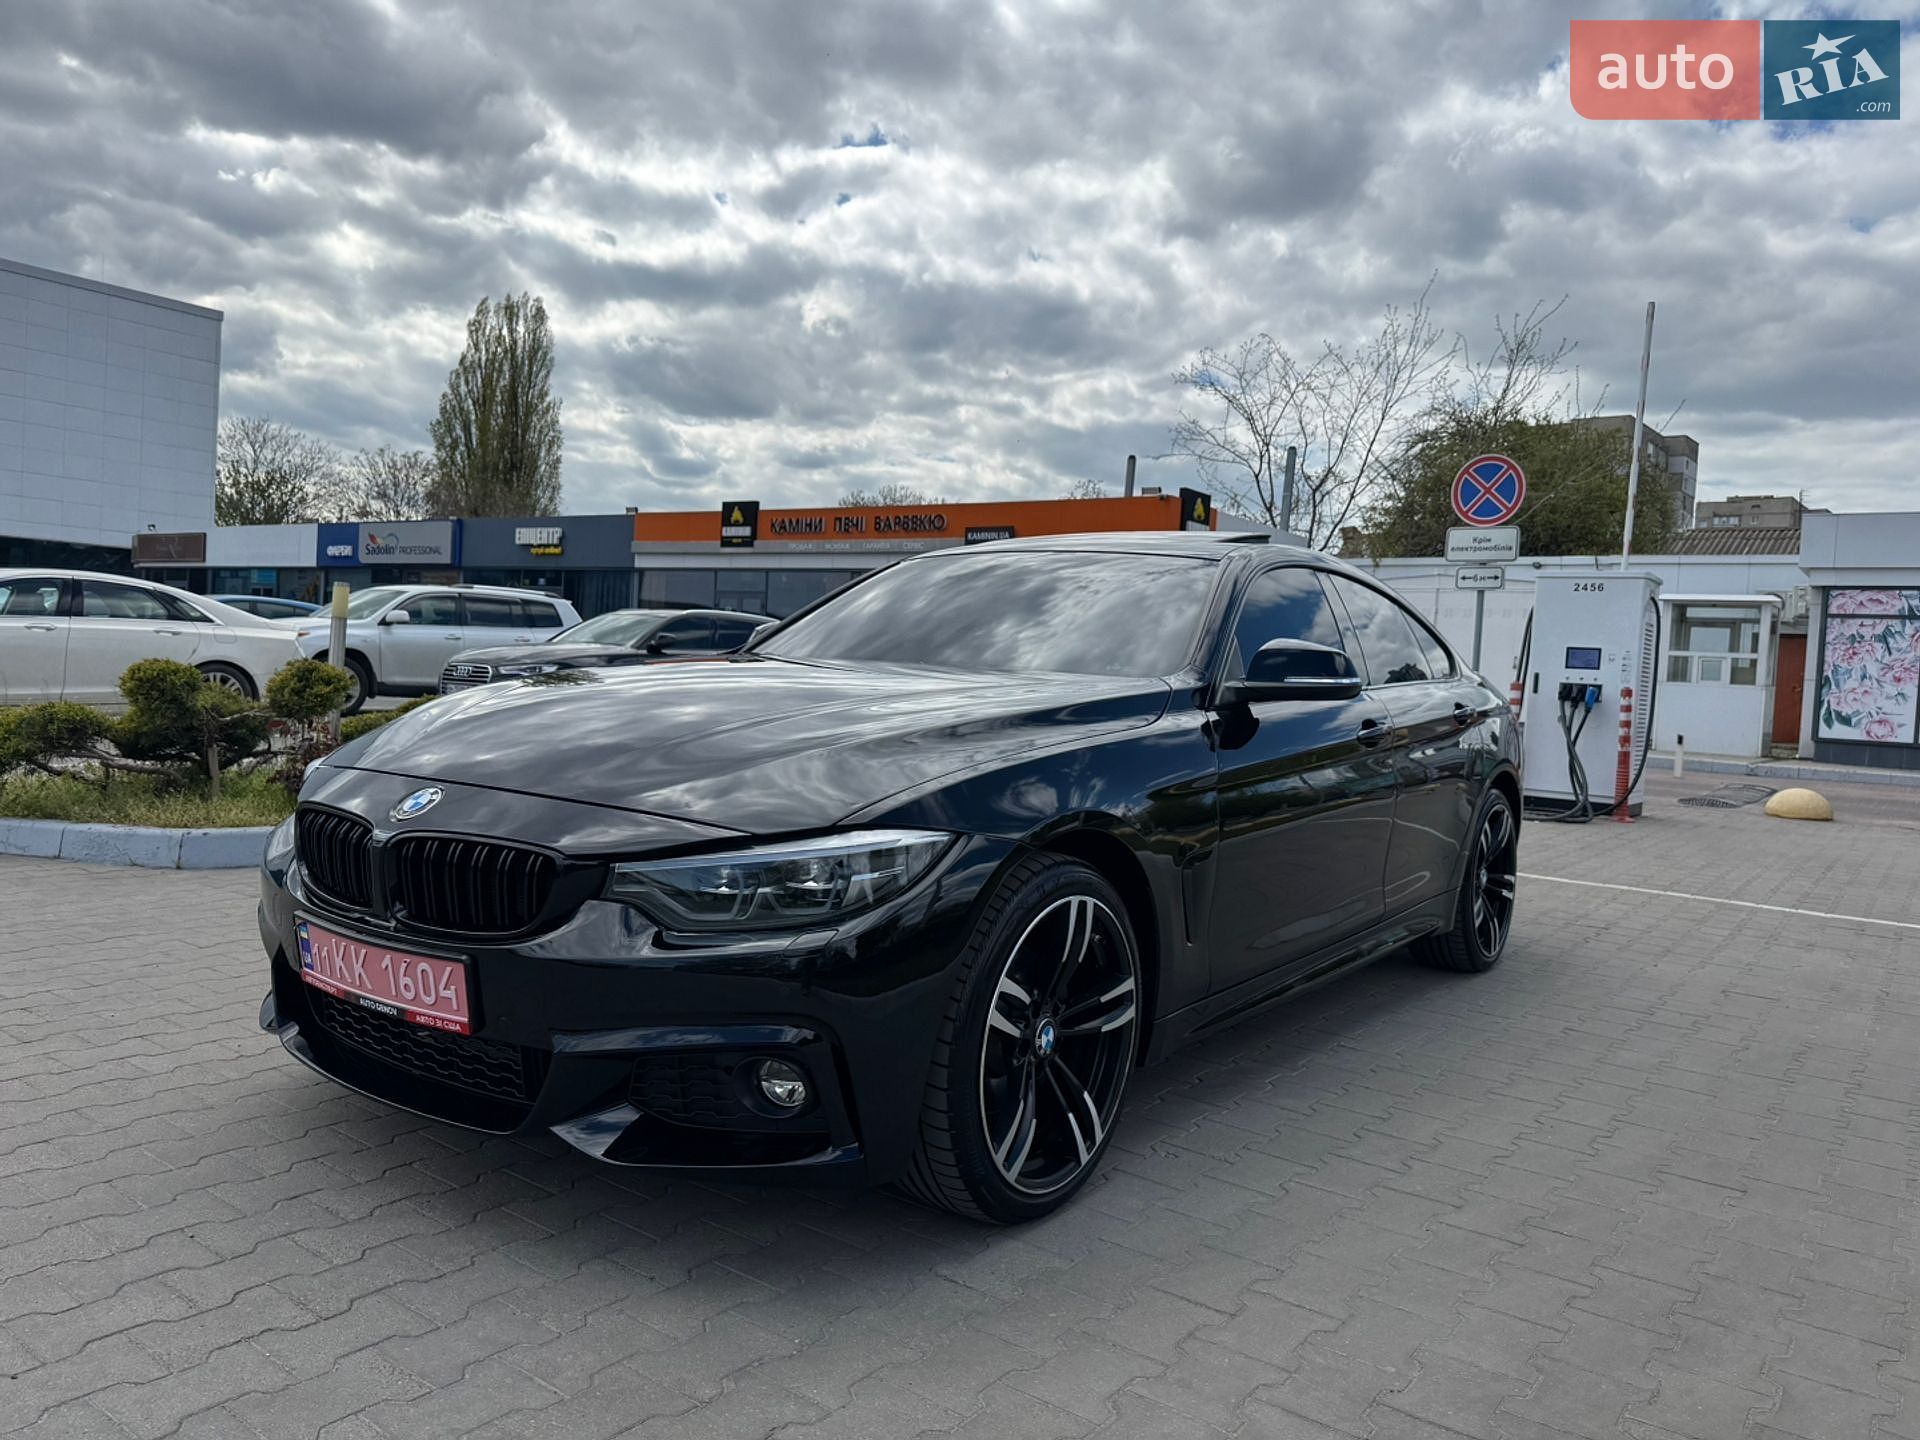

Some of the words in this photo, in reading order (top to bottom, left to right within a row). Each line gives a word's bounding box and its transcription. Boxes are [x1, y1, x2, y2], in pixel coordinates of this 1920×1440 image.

[770, 517, 825, 534] КАМІНИ
[834, 516, 866, 532] ПЕЧІ
[874, 513, 948, 532] БАРБЕКЮ
[364, 543, 395, 556] Sadolin
[1573, 582, 1605, 592] 2456
[381, 954, 459, 1011] 1604
